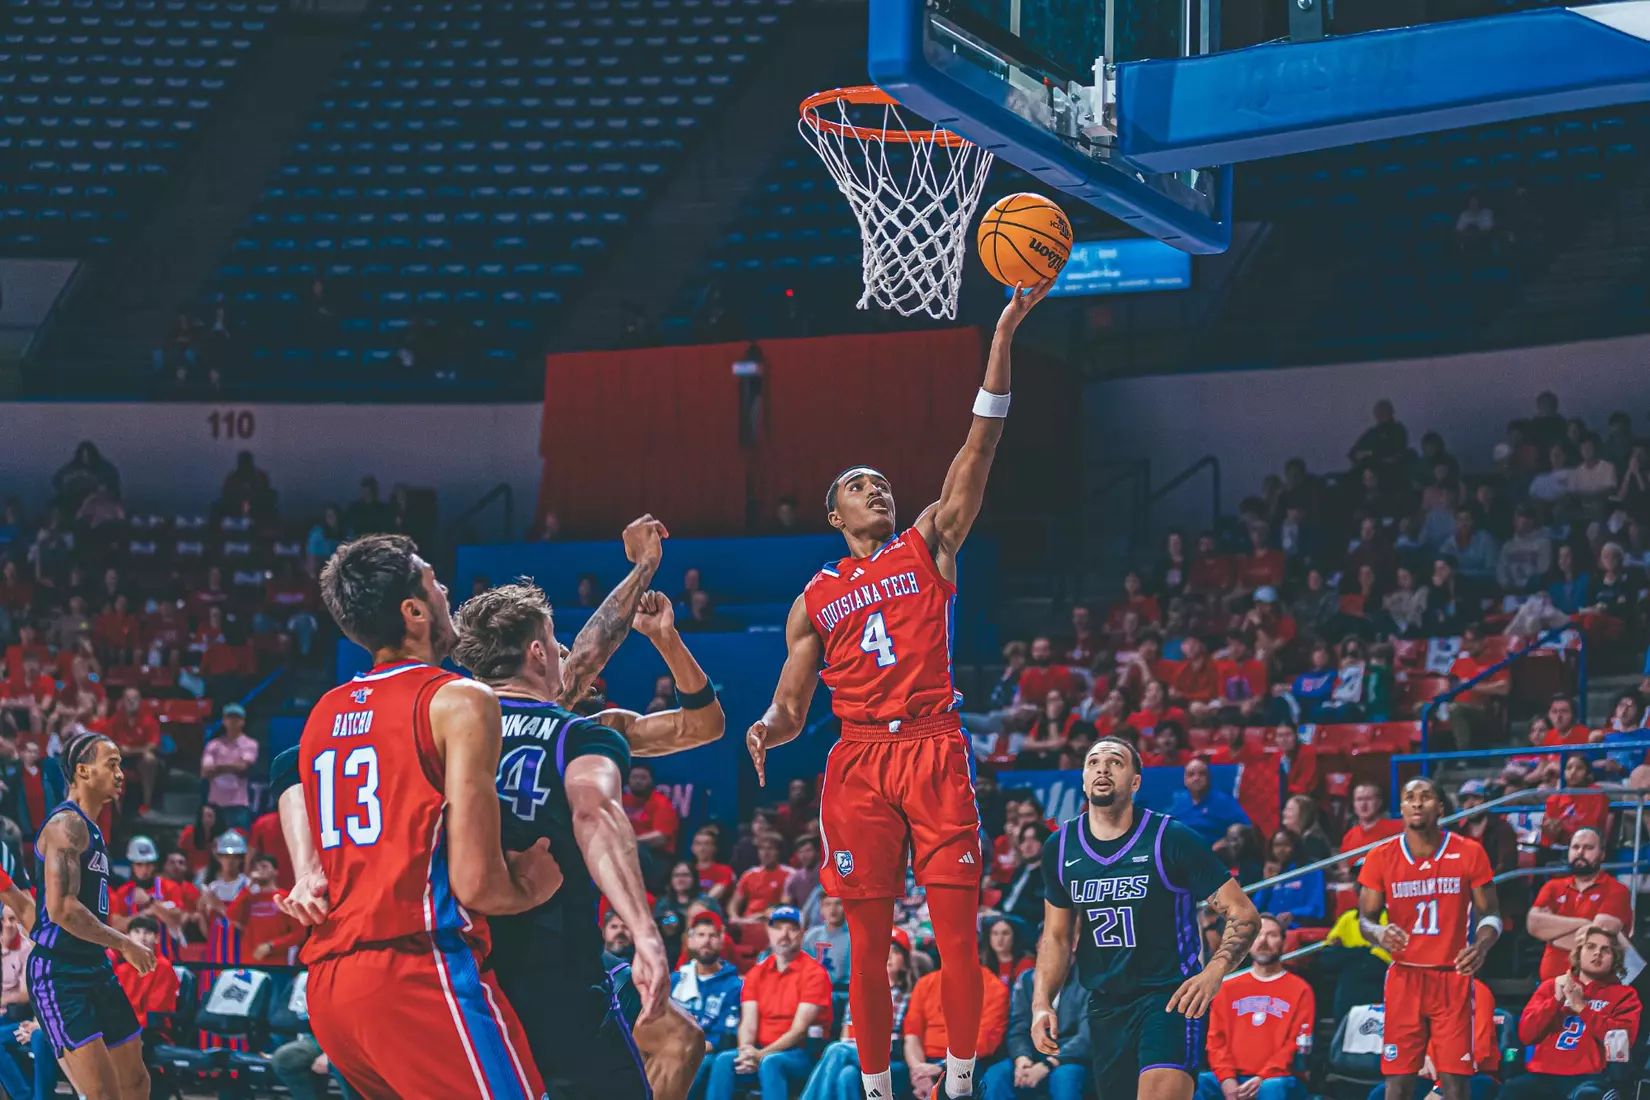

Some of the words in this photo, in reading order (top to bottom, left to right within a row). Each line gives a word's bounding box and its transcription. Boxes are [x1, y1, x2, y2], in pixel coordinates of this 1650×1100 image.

[207, 409, 256, 440] 110
[816, 582, 882, 633] LOUISIANA
[880, 571, 920, 598] TECH
[860, 611, 897, 668] 4
[331, 710, 374, 738] BATCHO
[312, 745, 383, 849] 13
[1071, 875, 1149, 903] LOPES
[1086, 906, 1137, 948] 21
[1411, 899, 1440, 936] 11
[1554, 1015, 1587, 1051] 2
